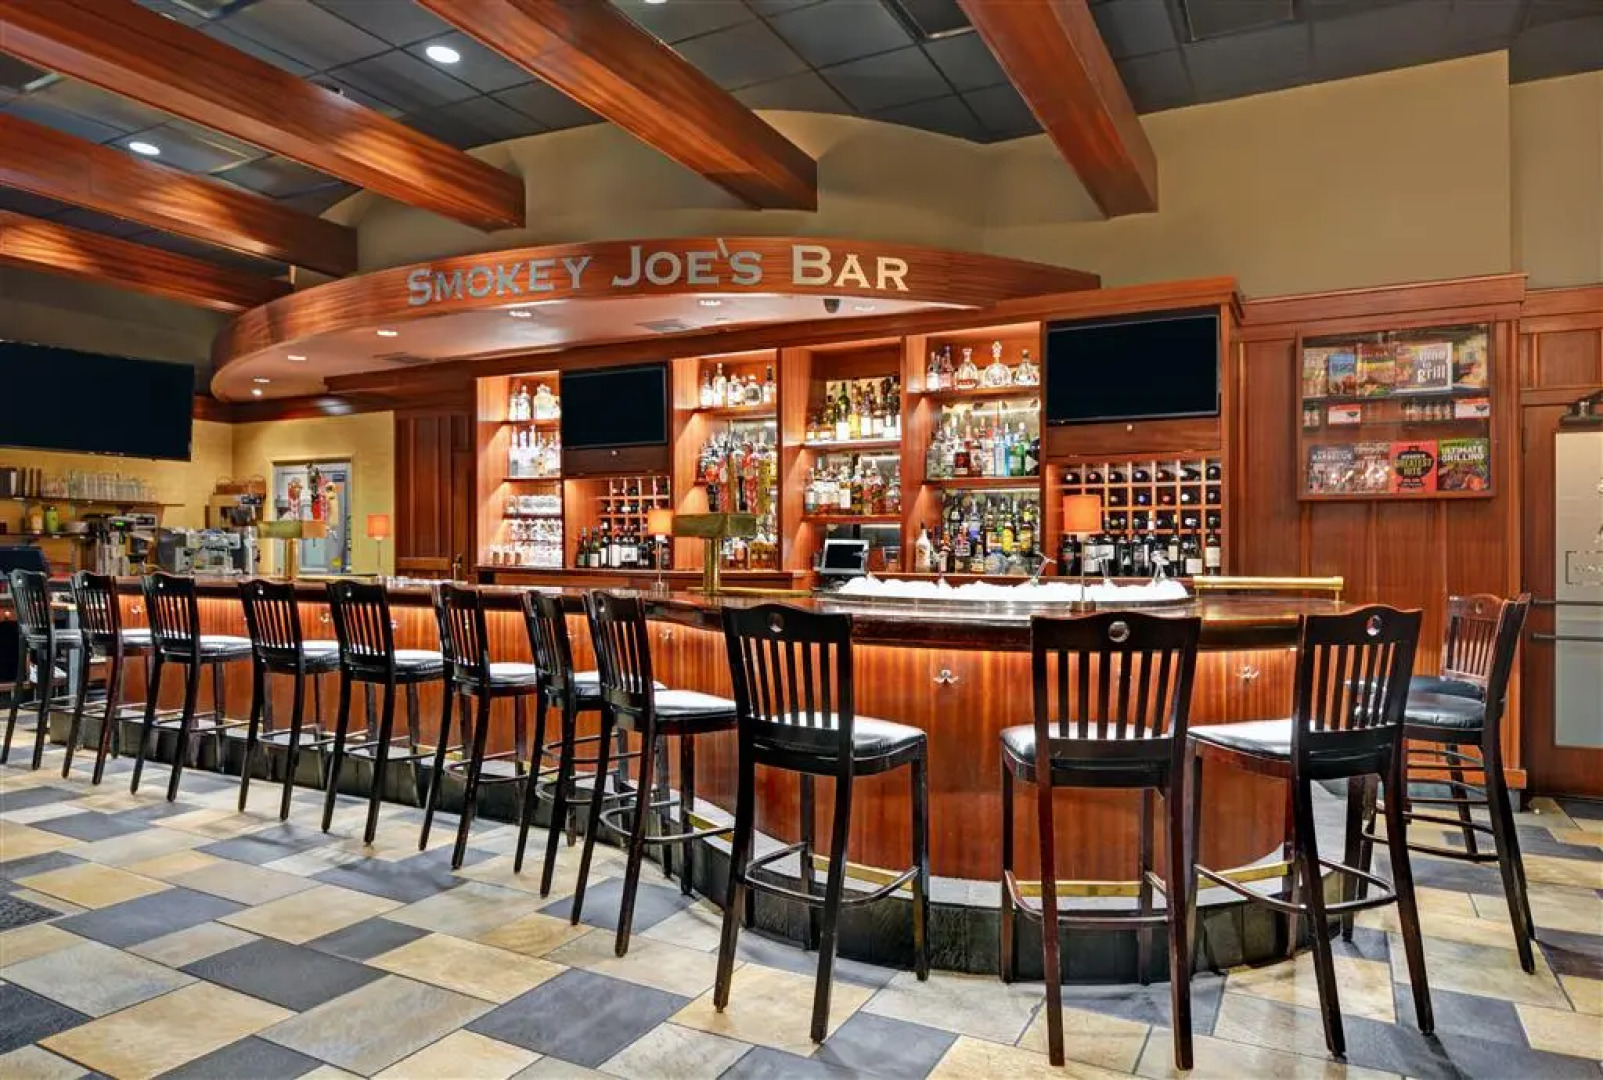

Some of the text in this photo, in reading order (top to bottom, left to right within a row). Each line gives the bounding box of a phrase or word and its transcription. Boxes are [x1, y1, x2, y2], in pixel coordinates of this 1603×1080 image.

[612, 238, 763, 286] JOE'S
[792, 244, 909, 291] BAR
[1417, 364, 1446, 383] grill
